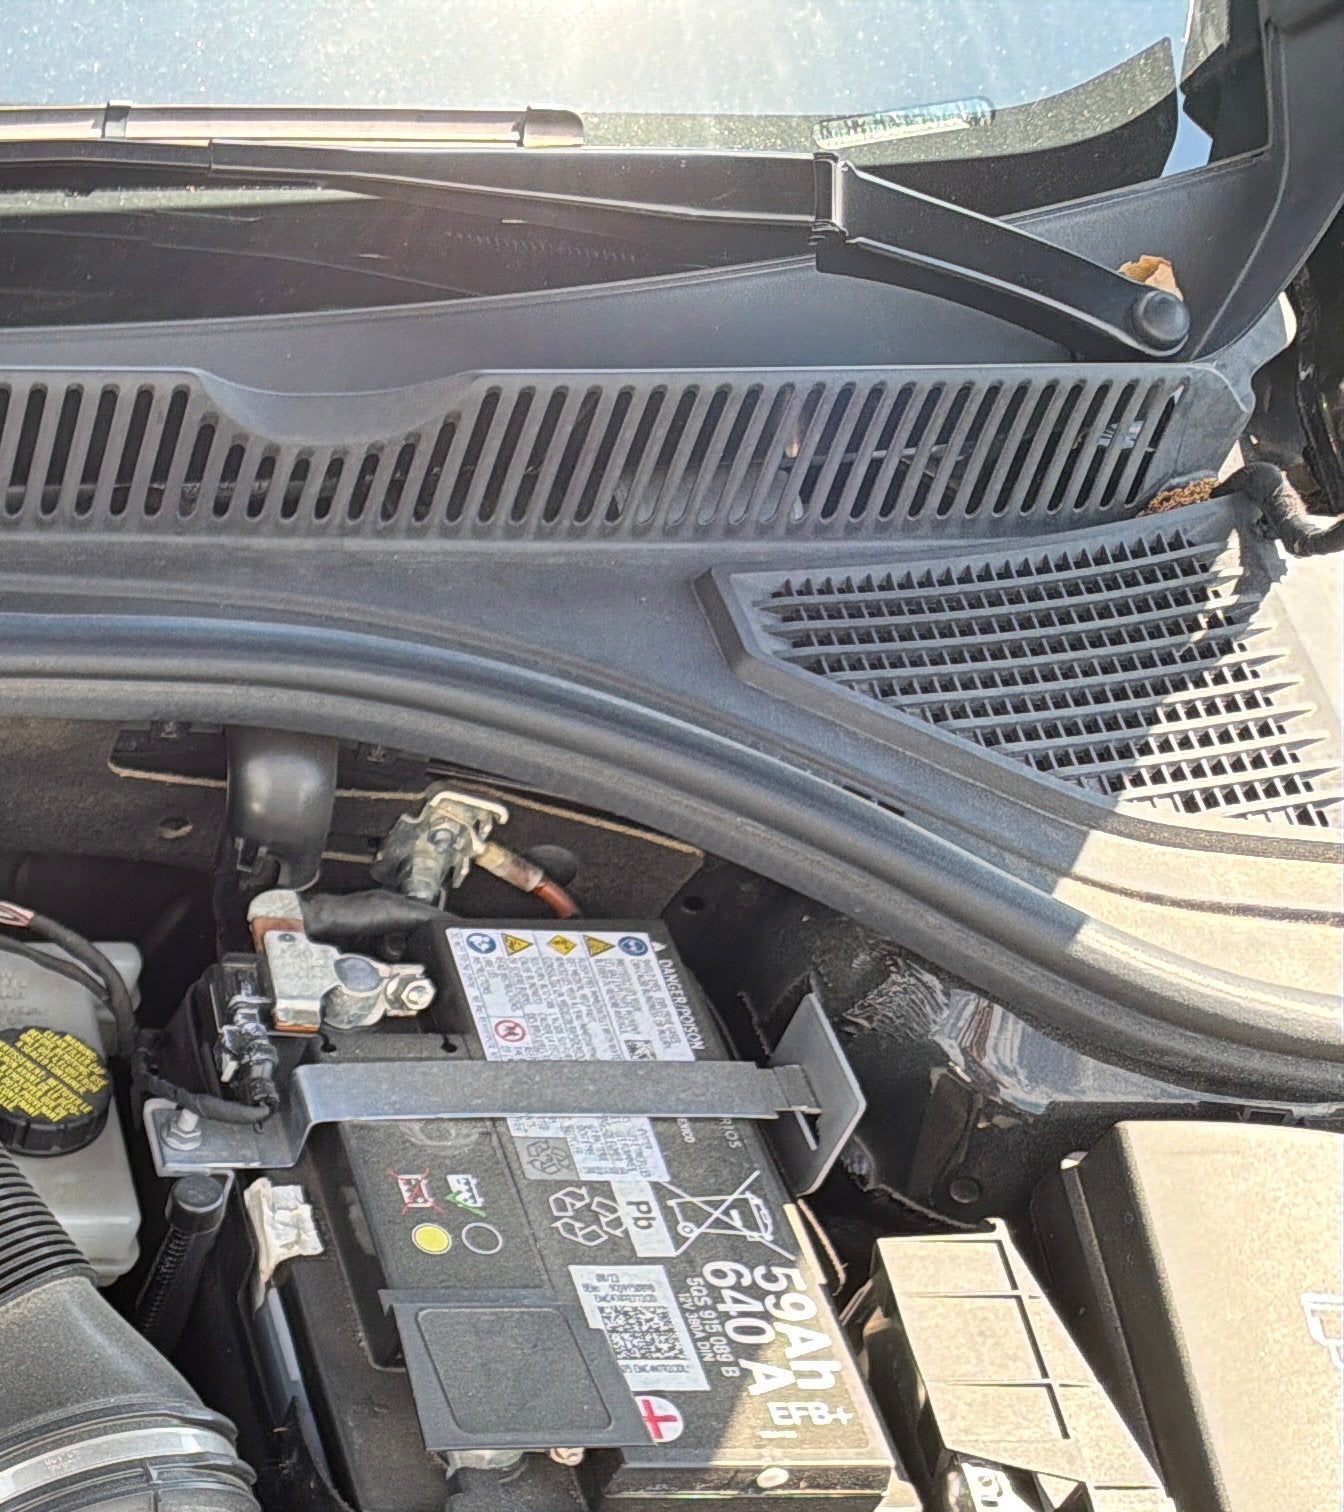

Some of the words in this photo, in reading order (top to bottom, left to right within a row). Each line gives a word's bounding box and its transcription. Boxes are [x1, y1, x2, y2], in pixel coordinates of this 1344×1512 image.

[659, 959, 705, 1049] DANGER/POISON
[676, 1118, 696, 1143] EXICO
[626, 1200, 657, 1229] Pb
[687, 1277, 712, 1306] 5QS
[702, 1261, 775, 1344] 640
[677, 1292, 696, 1310] 12V
[697, 1342, 715, 1361] DIN
[699, 1310, 722, 1333] 915
[753, 1265, 842, 1389] 59Ah
[710, 1337, 734, 1361] 089
[721, 1366, 741, 1377] B
[738, 1359, 795, 1396] A
[767, 1401, 854, 1425] EFB+
